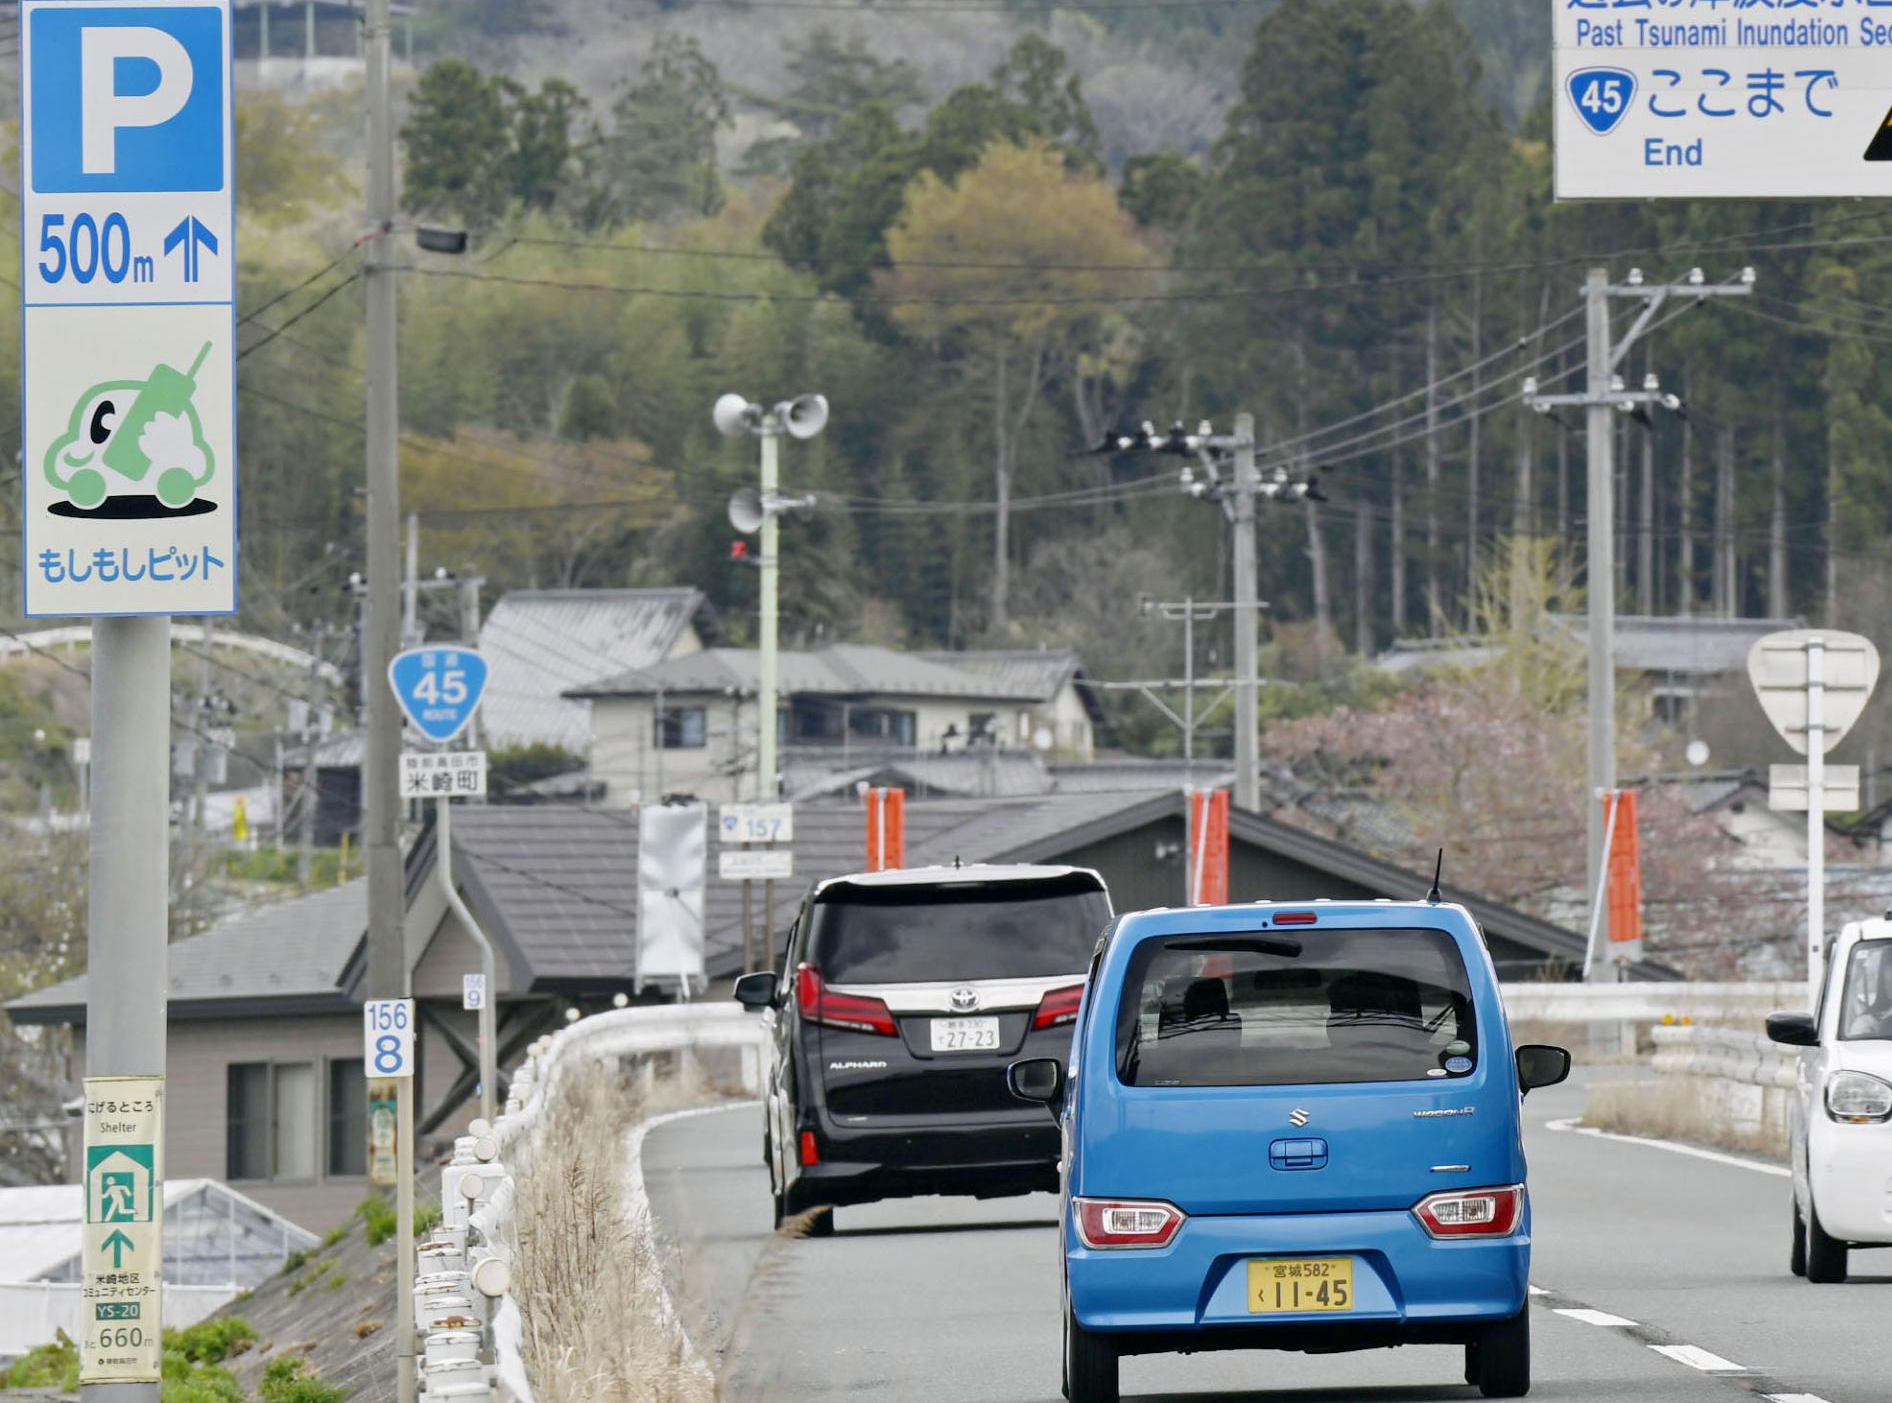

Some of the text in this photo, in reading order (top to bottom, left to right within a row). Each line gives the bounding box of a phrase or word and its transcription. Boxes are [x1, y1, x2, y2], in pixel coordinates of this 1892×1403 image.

[1577, 18, 1623, 46] Past
[1635, 18, 1727, 46] Tsunami
[1737, 17, 1848, 46] Inundation
[81, 26, 194, 174] P
[1582, 68, 1839, 118] 45 ここまで
[1645, 138, 1703, 166] End
[39, 212, 154, 284] 500m
[38, 546, 225, 583] もしもしピット
[412, 670, 469, 705] 45
[408, 770, 478, 792] 米崎町
[747, 818, 782, 839] 157
[468, 989, 481, 1008] 9
[368, 1003, 408, 1031] 156
[374, 1034, 403, 1074] 8
[829, 1060, 888, 1070] ALPHARD
[100, 1122, 137, 1134] Shelter
[1258, 1279, 1348, 1309] く 11-45
[97, 1304, 139, 1318] YS-20
